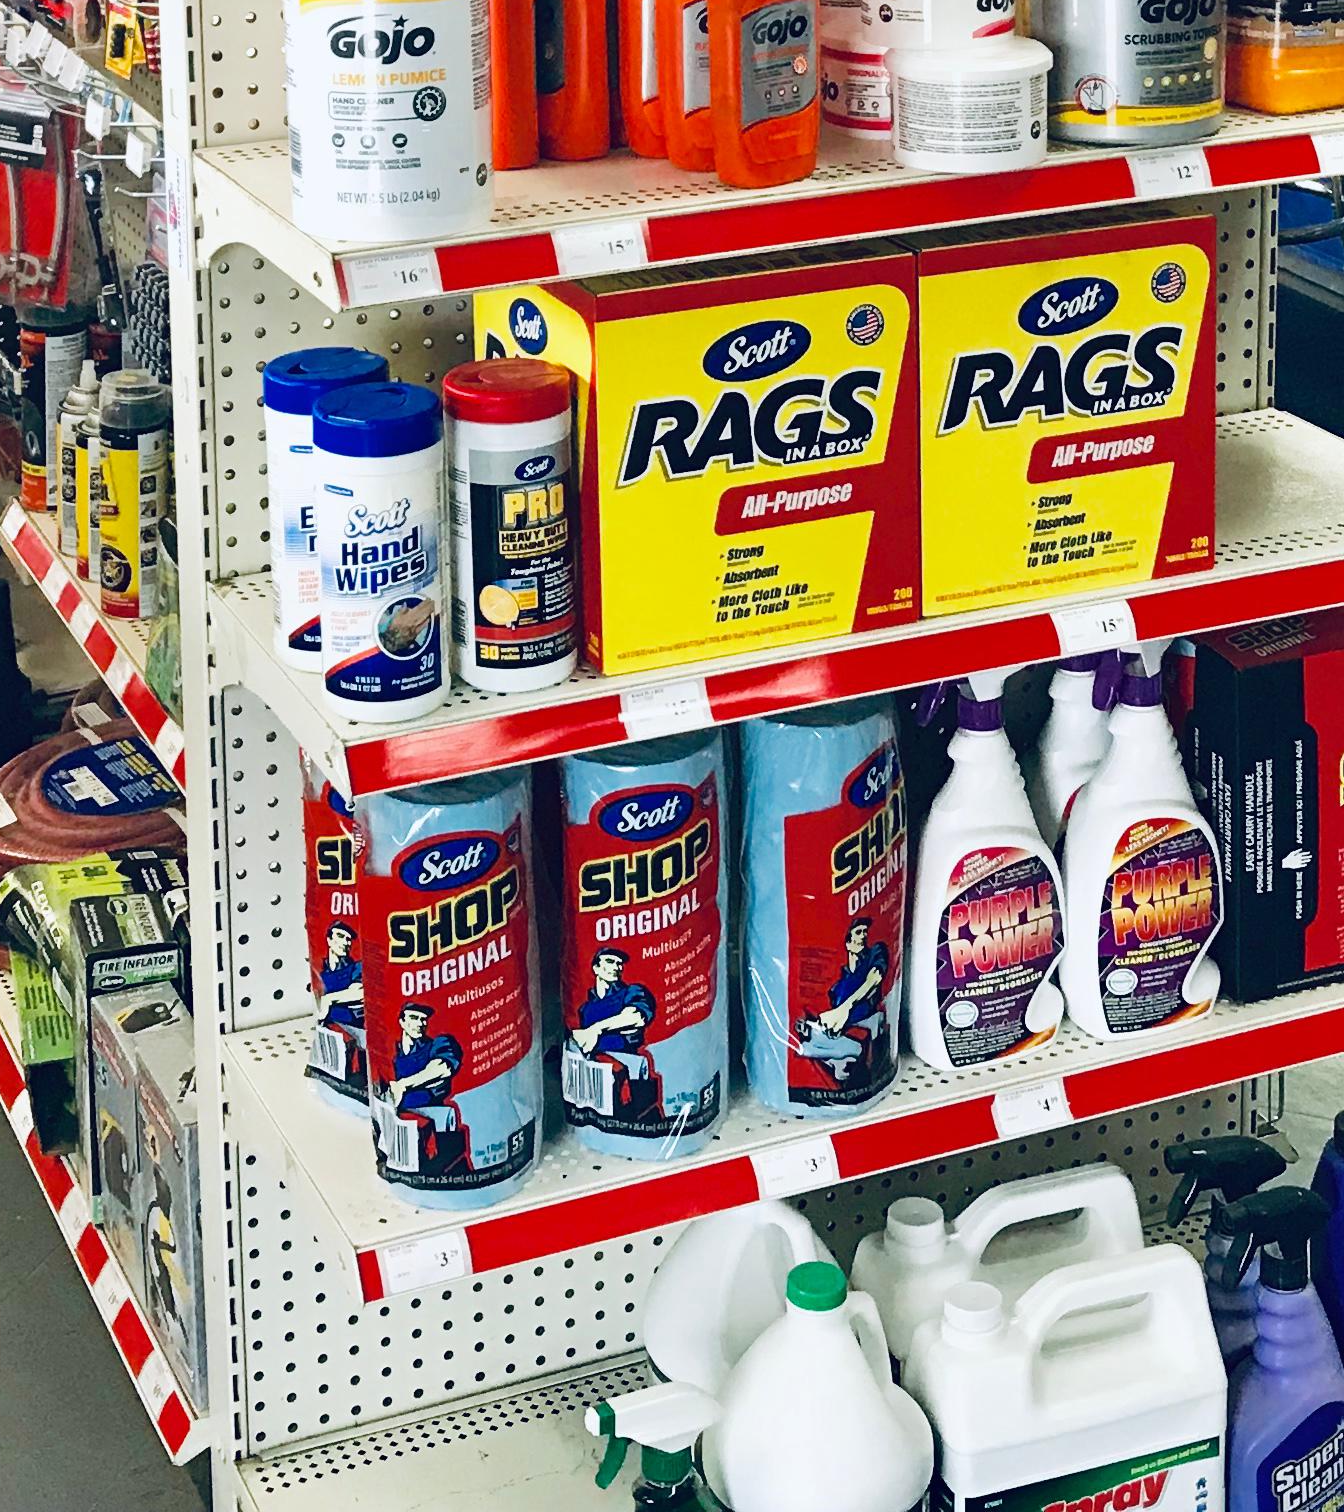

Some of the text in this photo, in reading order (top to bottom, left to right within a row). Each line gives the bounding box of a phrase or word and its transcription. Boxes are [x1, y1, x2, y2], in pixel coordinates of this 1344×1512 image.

[1124, 30, 1191, 46] SCRUBBING
[390, 68, 447, 86] PUMICE
[332, 97, 355, 106] HAND
[337, 192, 352, 203] NET
[387, 191, 398, 203] Lb
[1037, 283, 1102, 329] Scott
[513, 304, 544, 342] Scott
[722, 326, 795, 372] Scott
[936, 326, 1184, 438] RAGS
[1092, 389, 1165, 413] IN A BOX
[617, 369, 882, 488] RAGS
[784, 437, 864, 463] IN A BOX
[1051, 434, 1155, 469] All-Purpose
[523, 458, 549, 478] Scott
[504, 482, 564, 525] PRO
[740, 482, 853, 520] All-Purpose
[1037, 493, 1073, 508] Strong
[344, 498, 410, 539] Scott
[500, 522, 568, 544] HEAVY DUTY
[1034, 513, 1086, 531] Absorbent
[341, 525, 420, 567] Hand
[501, 539, 545, 552] CLEANING
[726, 544, 765, 561] Strong
[1027, 548, 1095, 569] to the Touch
[1029, 530, 1113, 555] More Cloth Like
[335, 554, 428, 594] Wipes
[723, 564, 779, 585] Absorbent
[716, 600, 789, 623] to the Touch
[718, 582, 808, 608] More Cloth Like
[480, 647, 499, 660] 30
[1254, 632, 1318, 658] ORIGINAL
[420, 653, 435, 671] 30
[618, 792, 682, 833] Scott
[1244, 773, 1255, 872] EASY CARRY HANDLE
[419, 838, 484, 882] Scott
[578, 821, 711, 913] SHOP
[1111, 853, 1213, 910] PURPLE
[388, 866, 521, 962] SHOP
[596, 888, 700, 941] ORIGINAL
[948, 880, 1054, 939] PURPLE
[1111, 889, 1213, 946] POWER
[98, 954, 175, 973] TIRE INFLATOR
[948, 916, 1054, 979] POWER
[400, 934, 513, 996] ORIGINAL
[447, 975, 505, 1008] Multiusos
[470, 998, 505, 1021] Absorbe
[703, 1087, 714, 1105] 55
[511, 1130, 524, 1153] 55
[1276, 1433, 1344, 1493] Super
[1279, 1456, 1344, 1512] Clean
